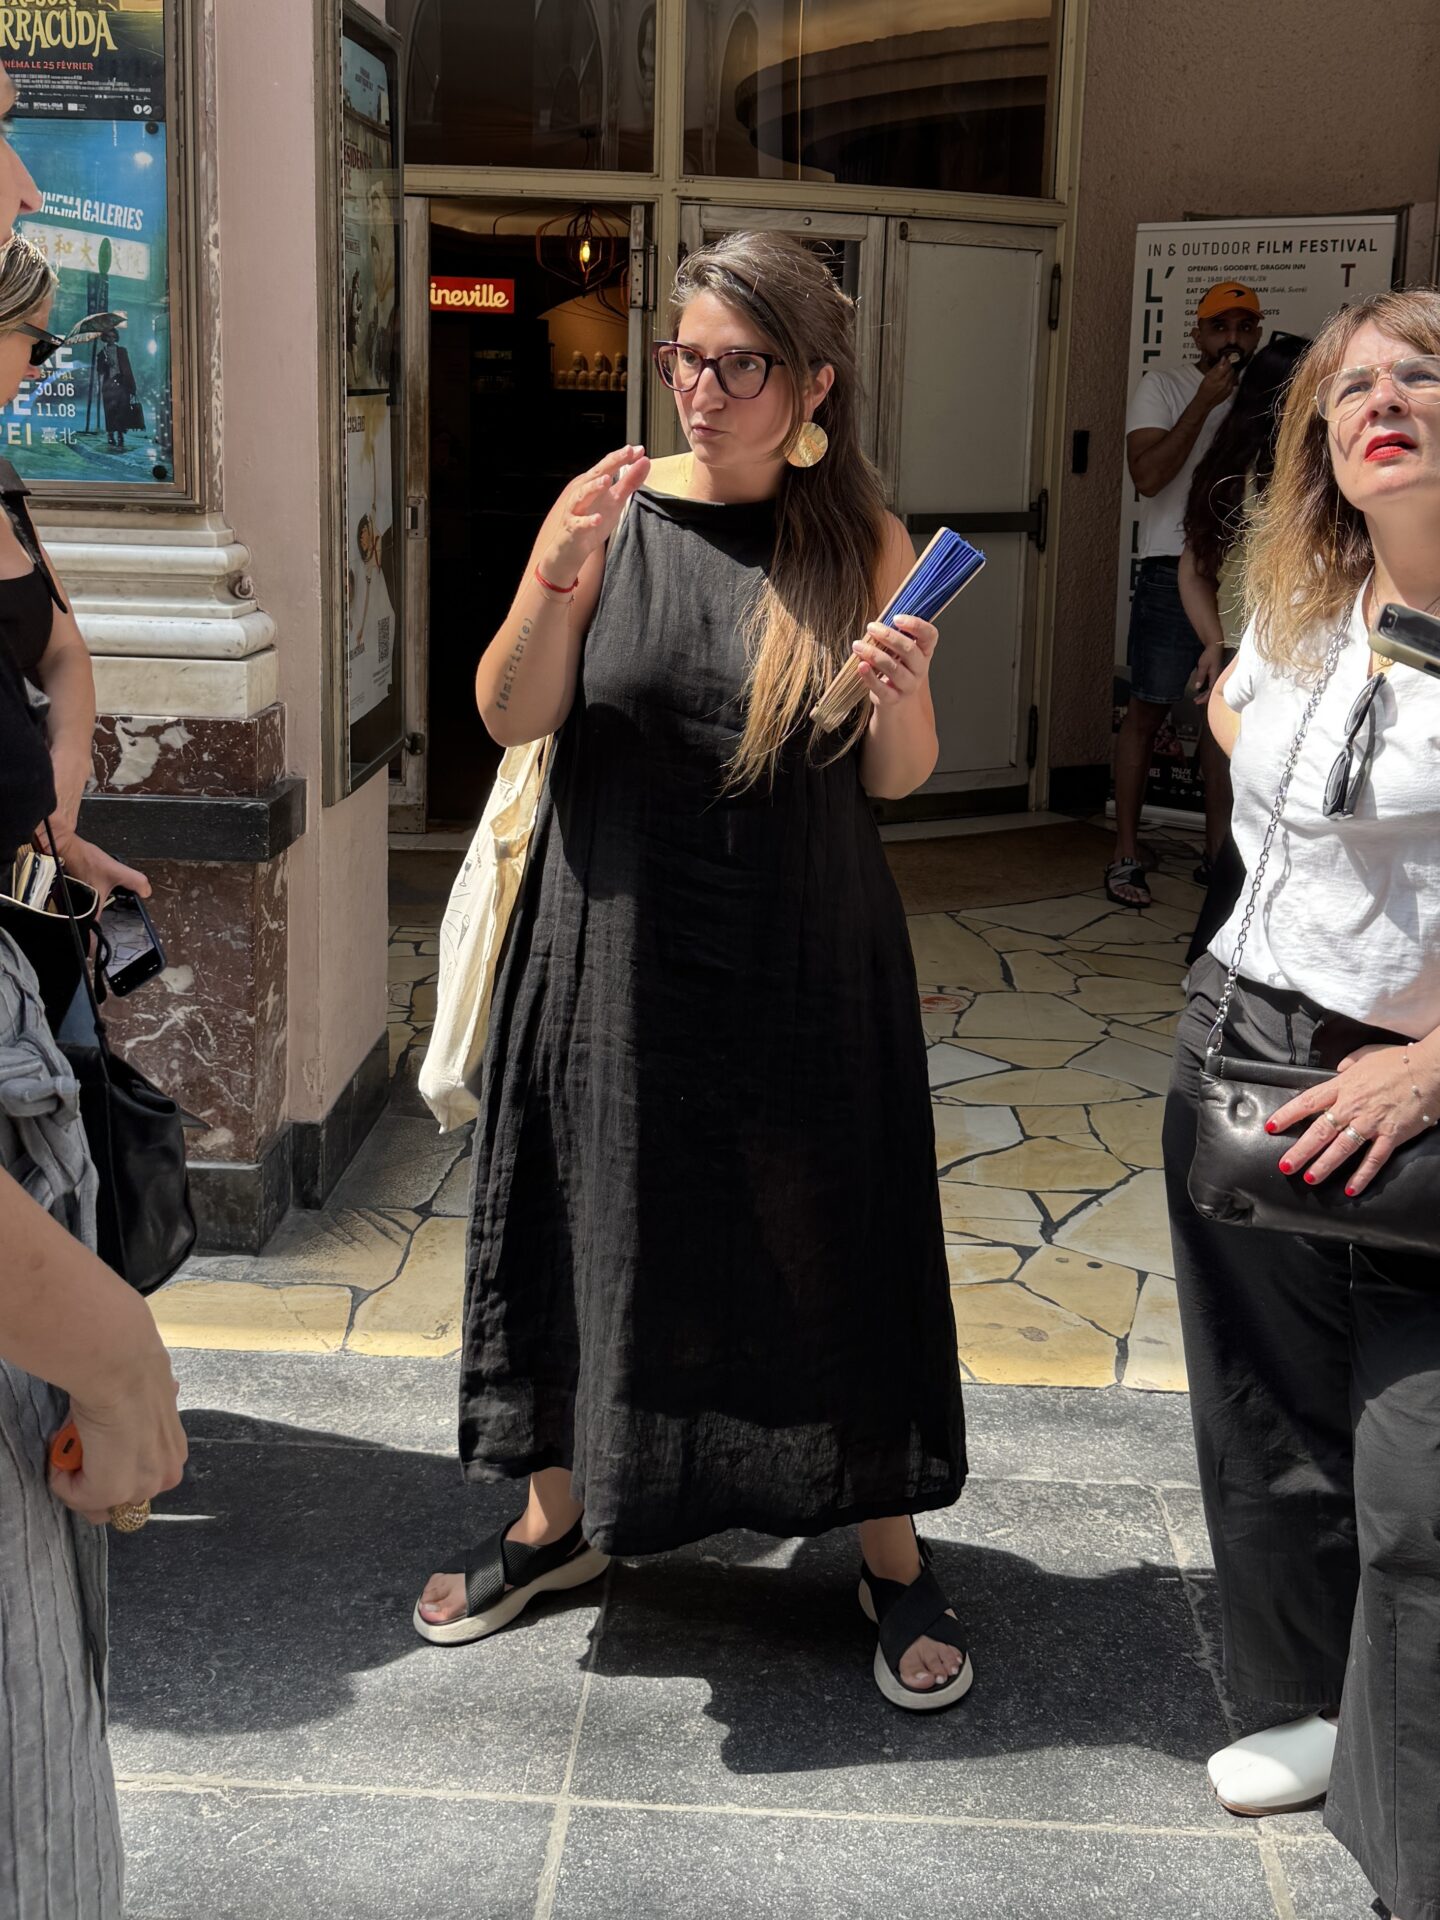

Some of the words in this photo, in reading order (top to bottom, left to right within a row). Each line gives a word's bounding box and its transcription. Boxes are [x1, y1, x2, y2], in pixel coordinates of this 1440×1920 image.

[31, 60, 42, 69] LE
[43, 61, 55, 70] 25
[1148, 243, 1162, 257] IN
[1167, 243, 1177, 256] &
[1182, 241, 1251, 256] OUTDOOR
[1256, 240, 1293, 254] FILM
[1299, 238, 1378, 253] FESTIVAL
[1187, 264, 1218, 272] OPENING
[1223, 264, 1259, 272] GOODBYE,
[1260, 263, 1291, 271] DRAGON
[430, 282, 510, 308] ineville
[35, 382, 75, 397] 30.06
[36, 402, 76, 417] 11.08
